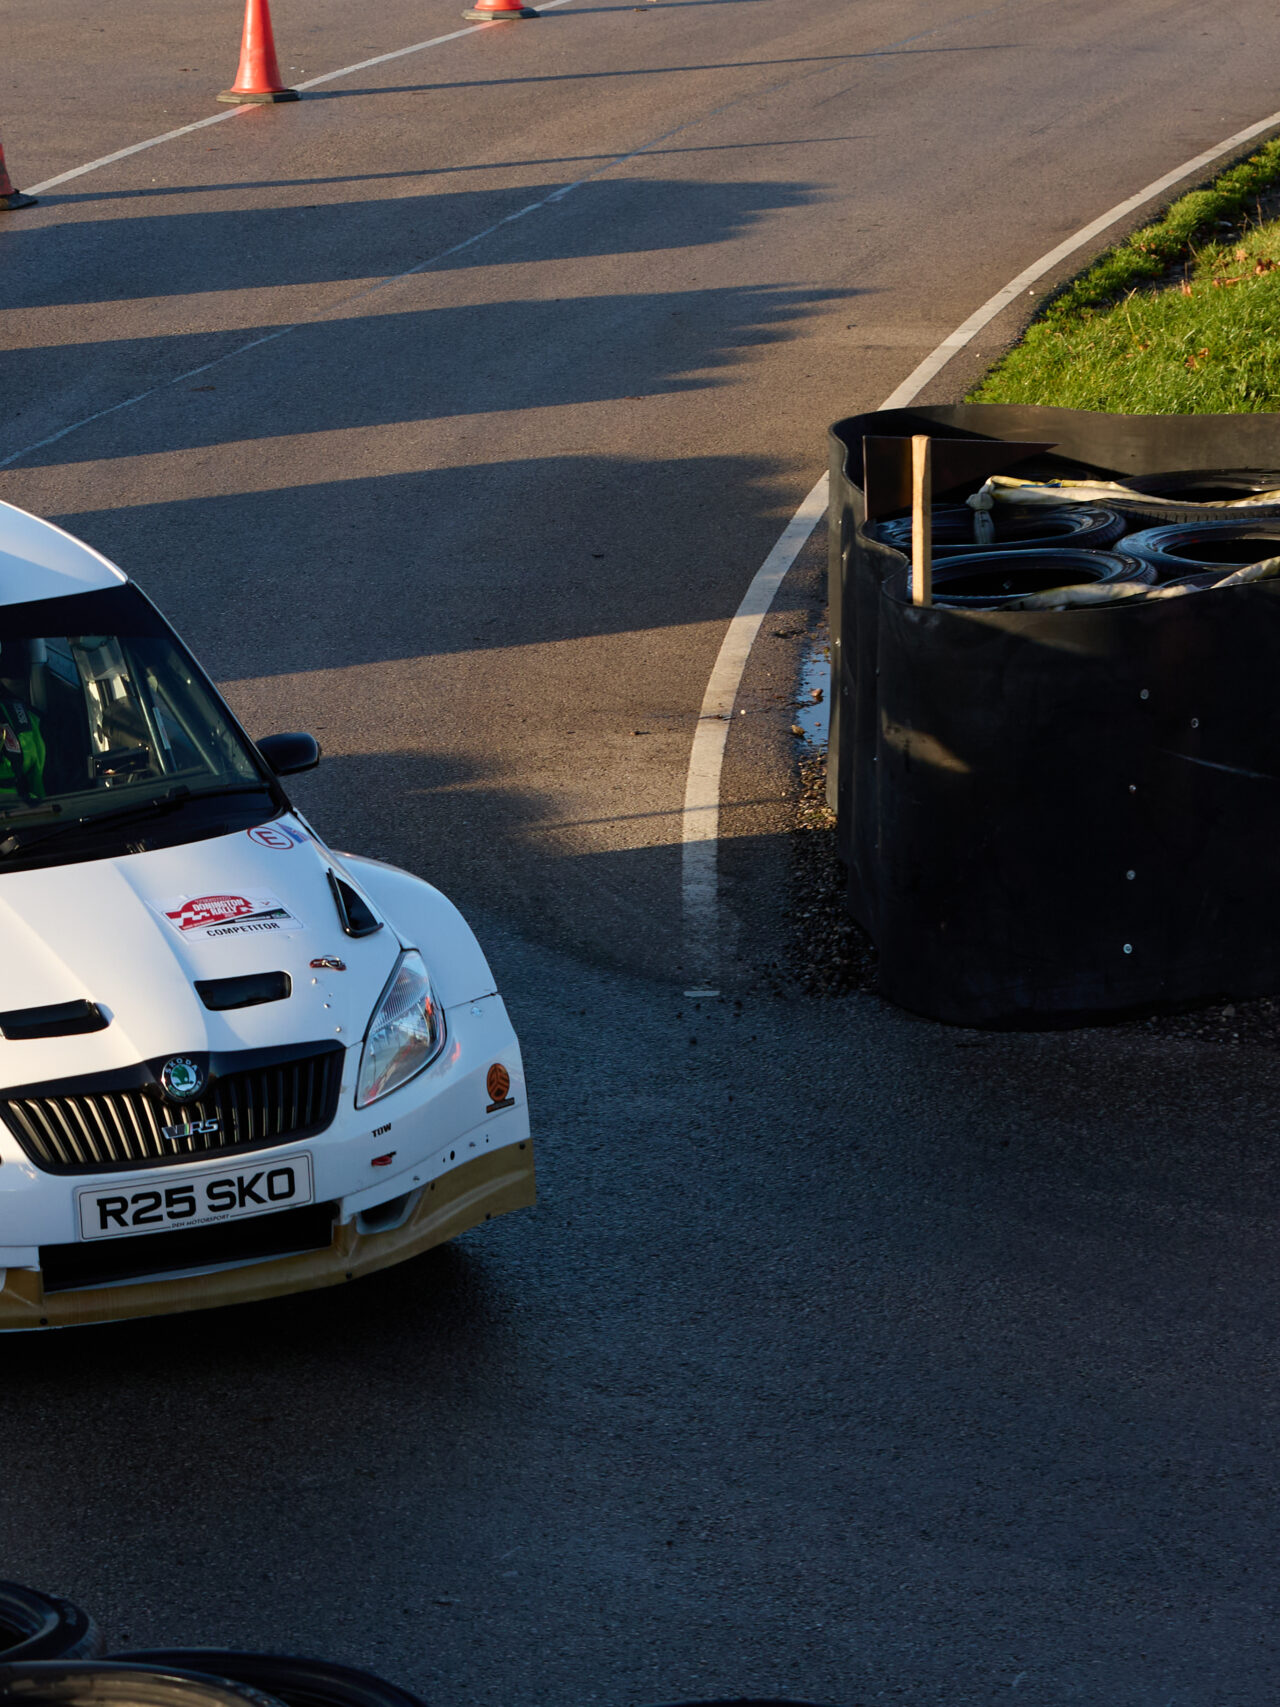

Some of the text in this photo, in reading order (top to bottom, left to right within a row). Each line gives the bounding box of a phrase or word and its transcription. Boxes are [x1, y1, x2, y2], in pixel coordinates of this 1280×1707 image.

[193, 899, 244, 911] DONINGTON
[210, 906, 238, 915] RALLY
[206, 922, 281, 937] COMPETITOR
[371, 1122, 392, 1138] TOW
[96, 1167, 296, 1230] R25 SKO
[186, 1214, 230, 1226] MOTORSPORT
